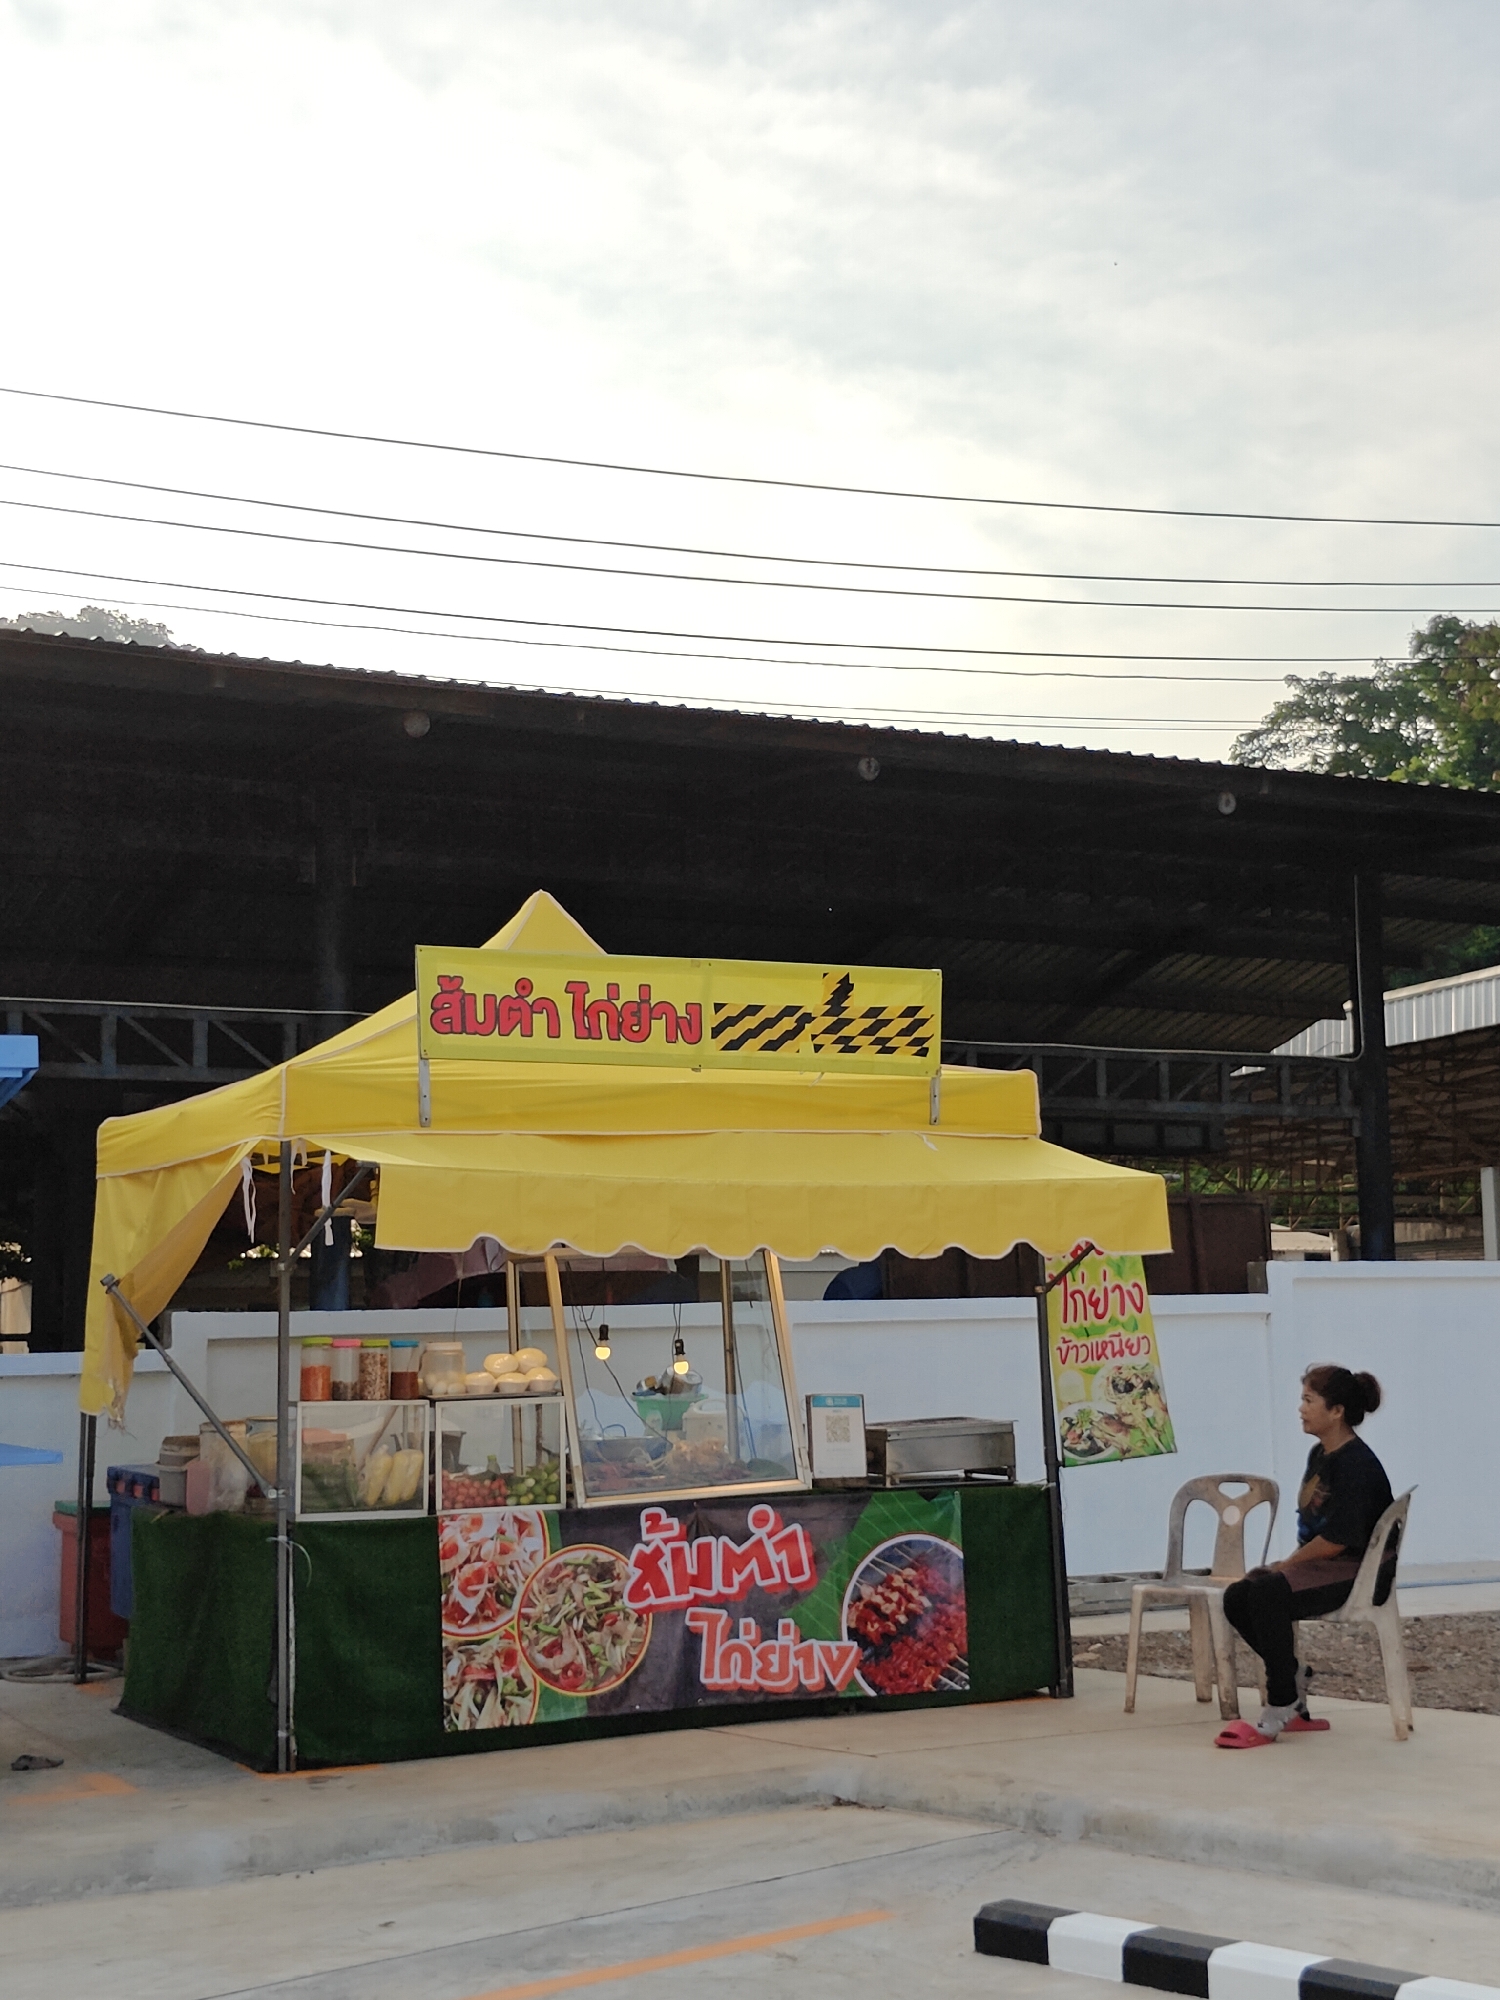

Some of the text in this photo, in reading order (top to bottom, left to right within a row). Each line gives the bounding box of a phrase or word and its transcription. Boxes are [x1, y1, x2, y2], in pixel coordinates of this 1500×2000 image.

[430, 975, 702, 1045] ส้มตำ ไก่ย่าง
[1048, 1269, 1144, 1324] ไก่ย่าง
[1056, 1332, 1151, 1365] ข้าวเหนียว
[623, 1504, 815, 1612] ส้มตำ
[685, 1607, 861, 1692] ไก่ย่าง
